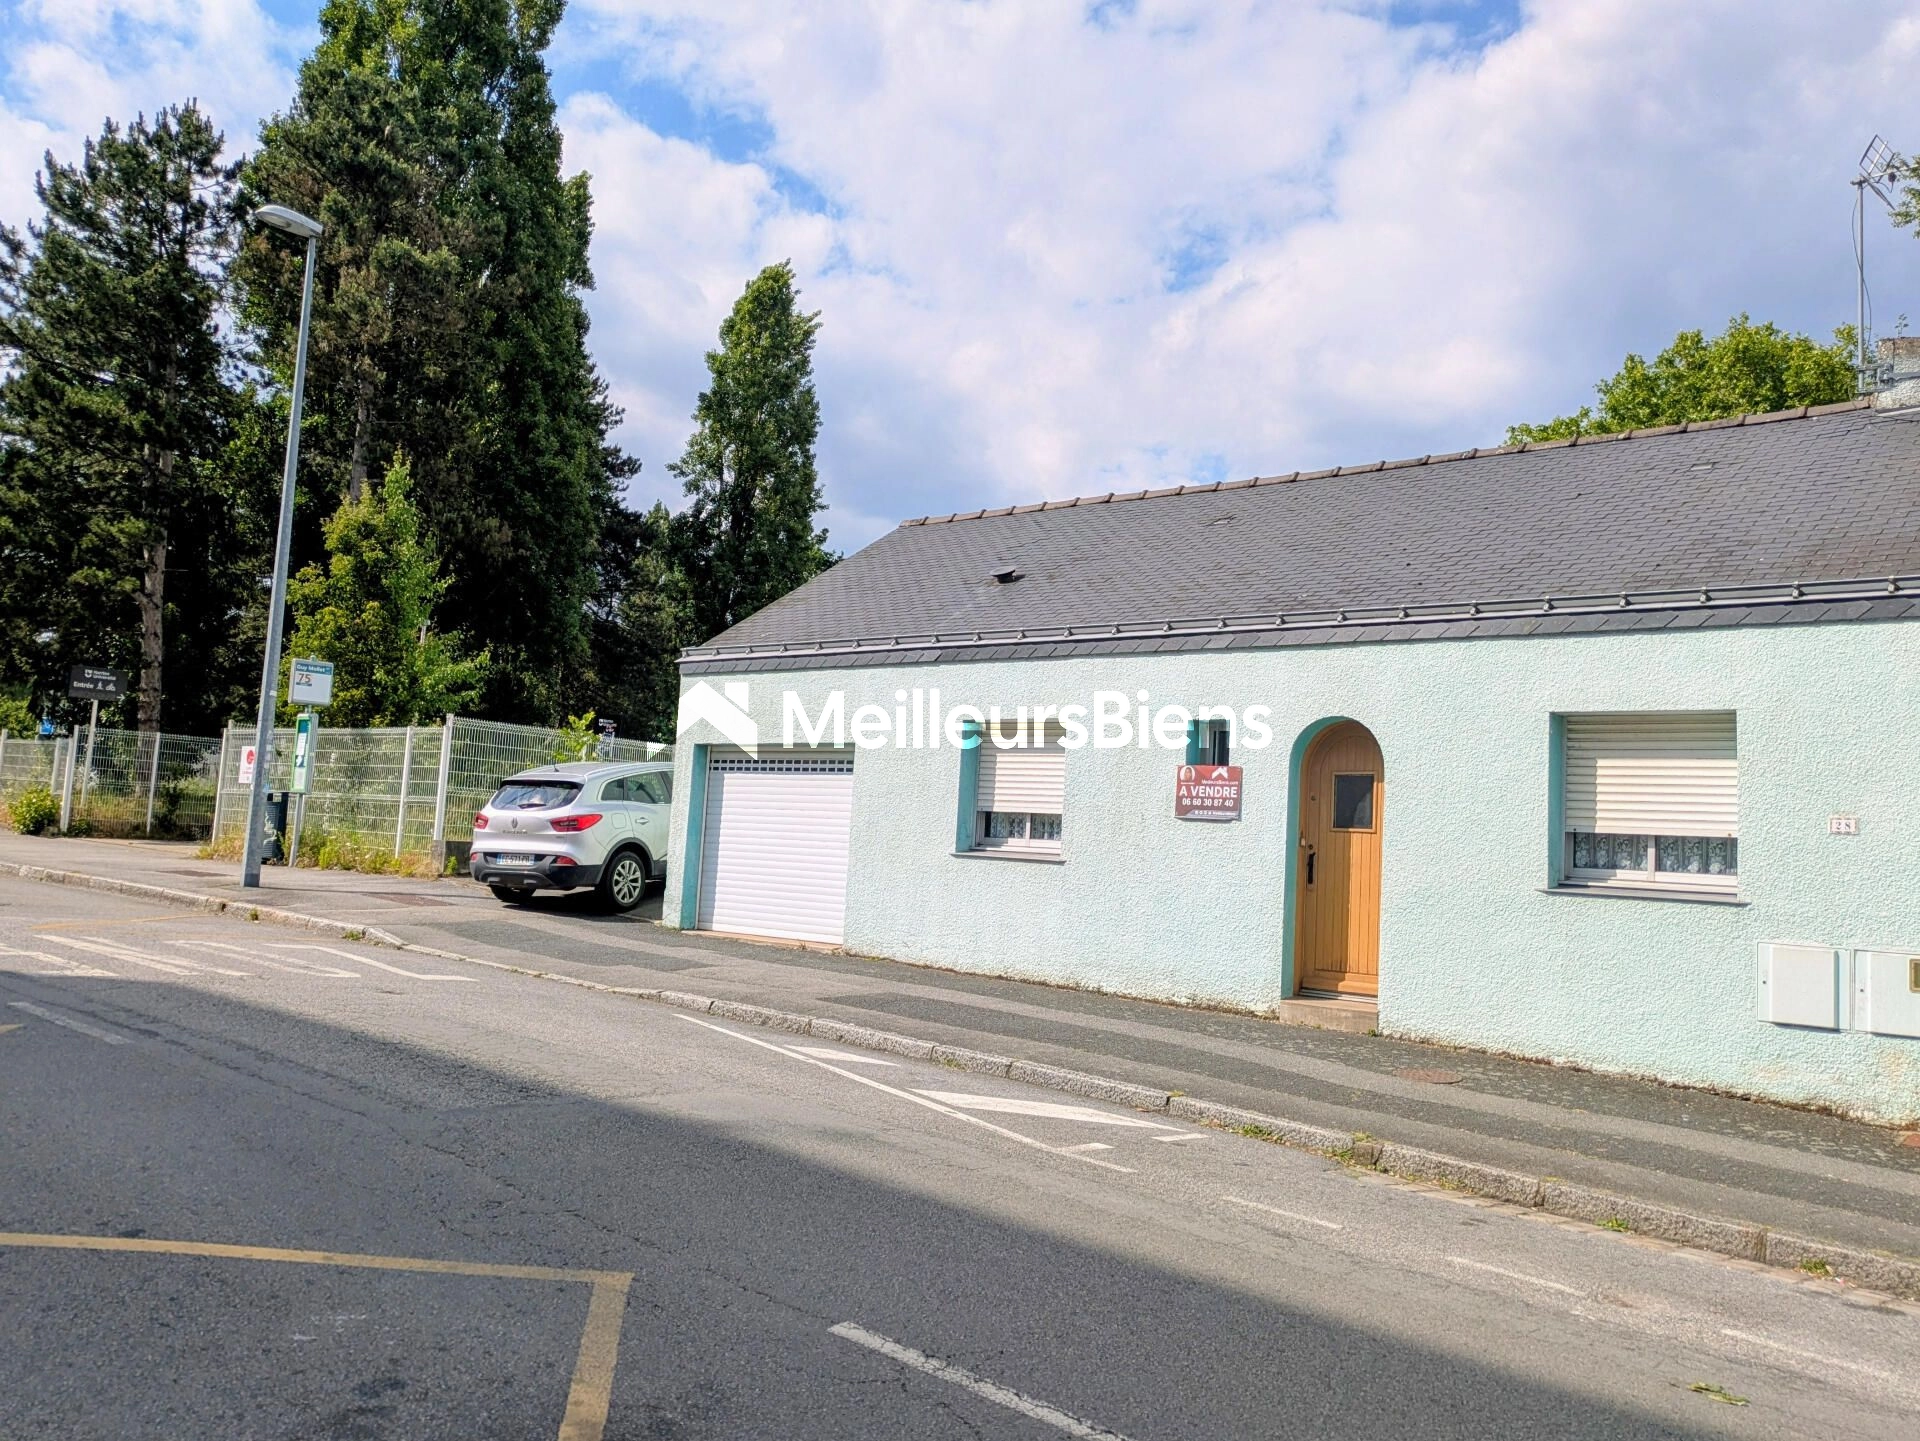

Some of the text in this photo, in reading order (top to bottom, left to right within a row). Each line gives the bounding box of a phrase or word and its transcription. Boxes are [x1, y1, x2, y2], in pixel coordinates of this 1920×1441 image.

[296, 664, 307, 672] Guy
[298, 673, 311, 683] 75
[1179, 785, 1238, 797] A VENDRE
[1182, 797, 1234, 807] 06 60 30 87 40
[1836, 821, 1851, 830] 28
